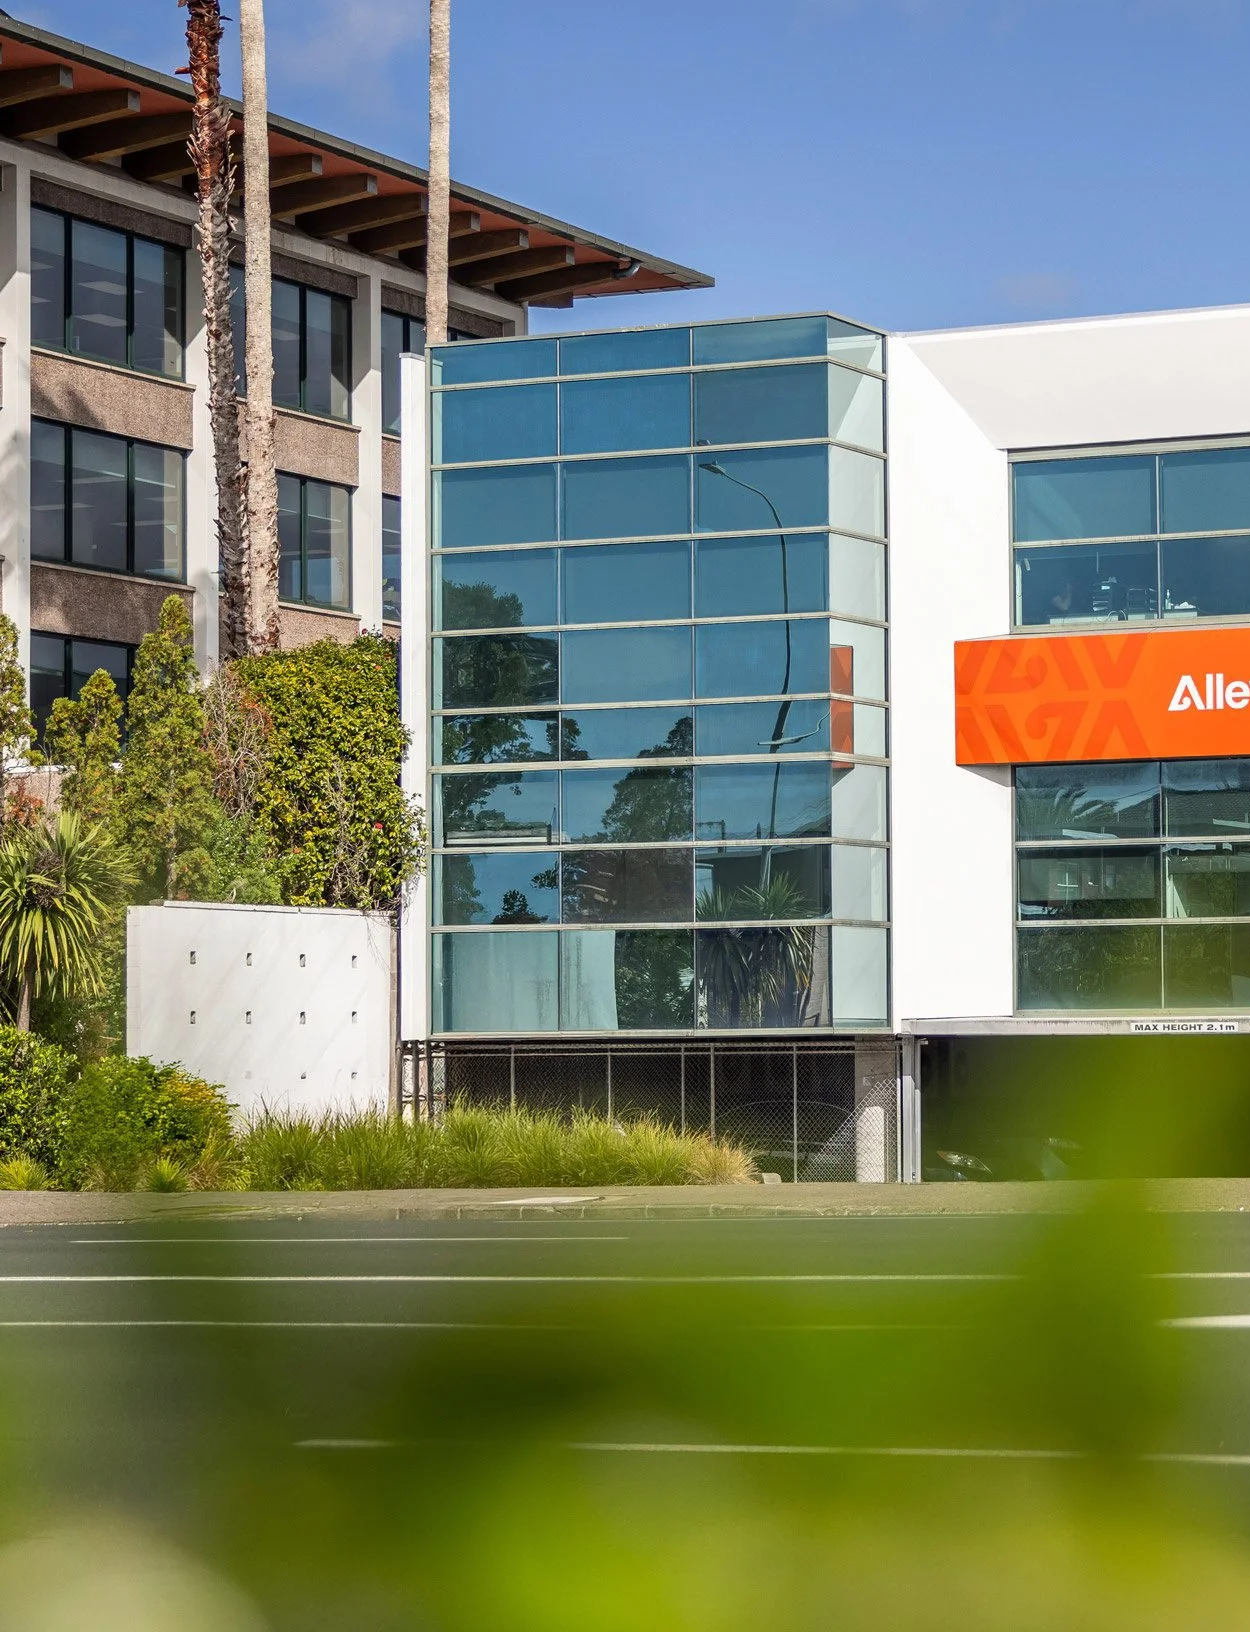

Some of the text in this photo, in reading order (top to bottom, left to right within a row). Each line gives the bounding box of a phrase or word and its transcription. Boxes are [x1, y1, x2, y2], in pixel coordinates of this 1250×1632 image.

[1134, 1023, 1235, 1031] MAX HEIGHT 2.1m
